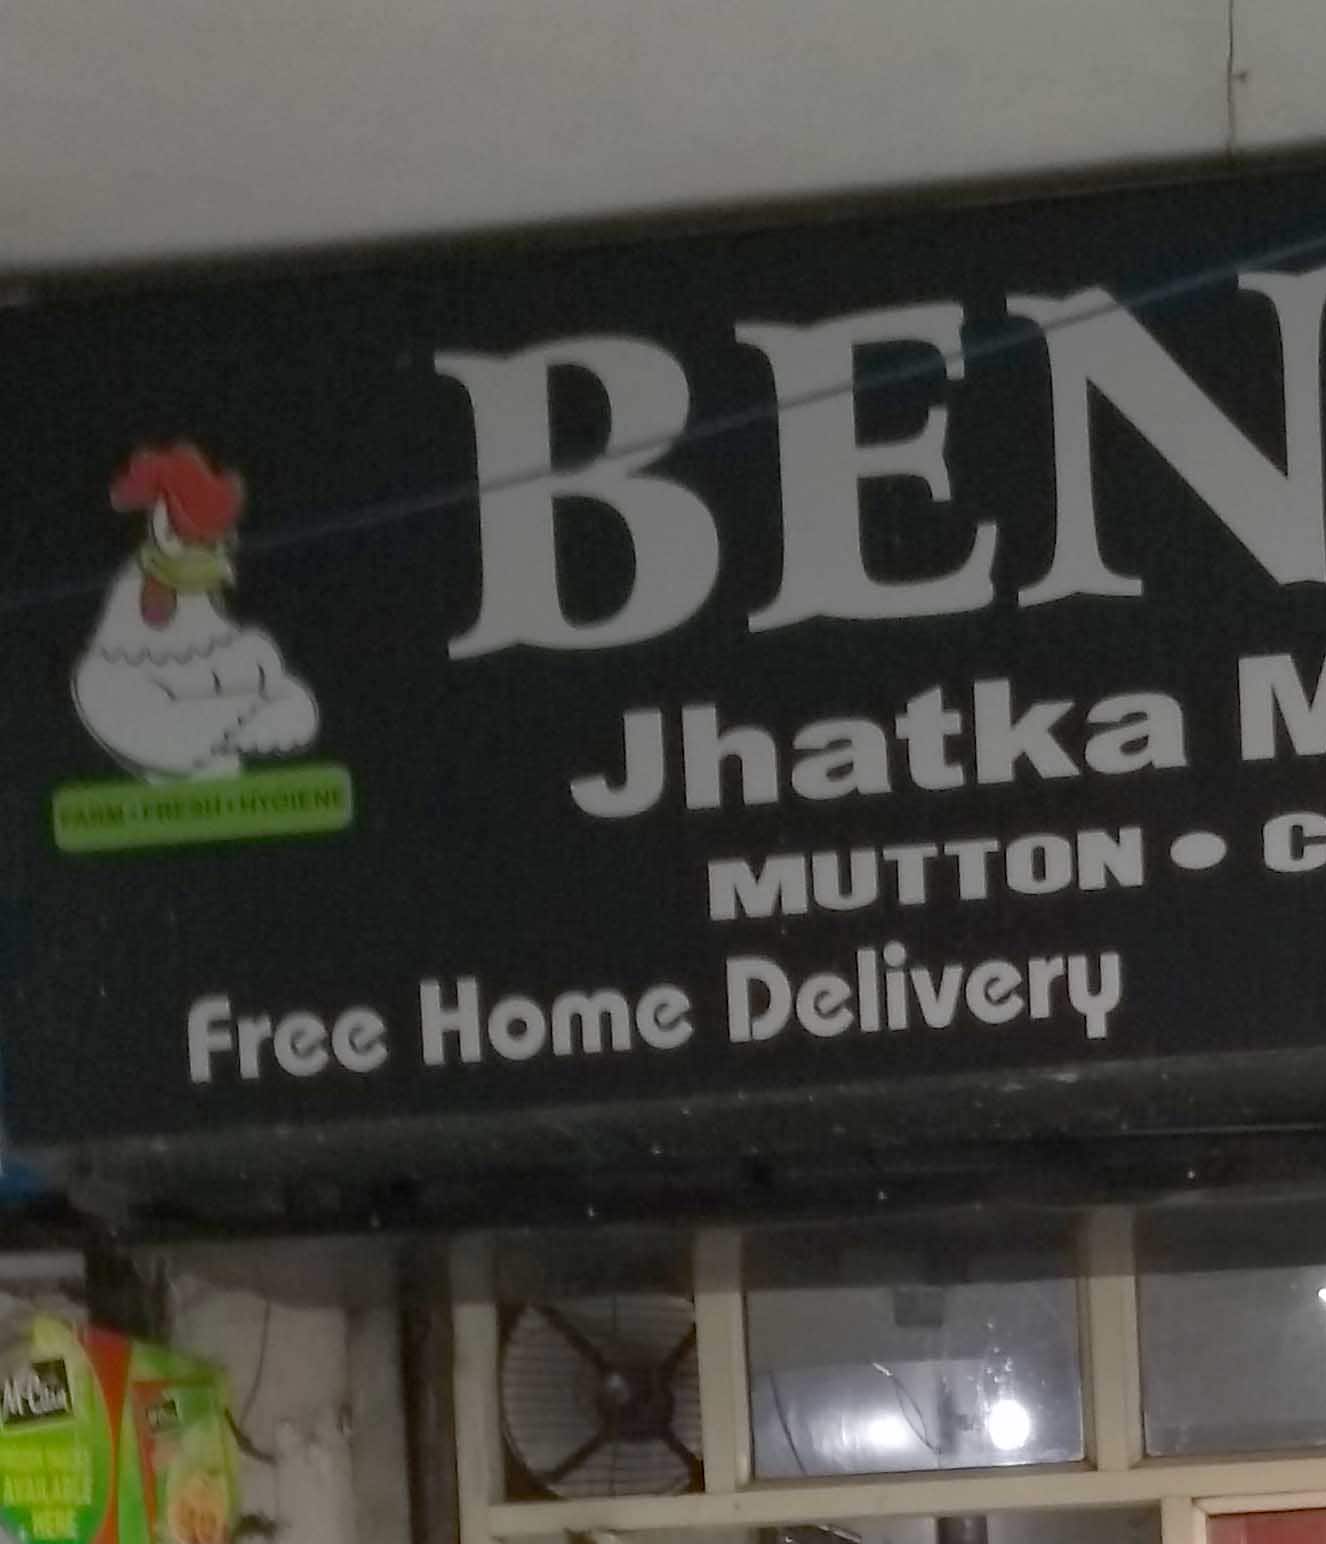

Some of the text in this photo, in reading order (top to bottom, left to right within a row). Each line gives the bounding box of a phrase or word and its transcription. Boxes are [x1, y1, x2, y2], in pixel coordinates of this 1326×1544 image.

[570, 678, 1188, 818] Jhatka
[707, 826, 1145, 921] MUTTON
[187, 940, 1123, 1083] Free Home Delivery
